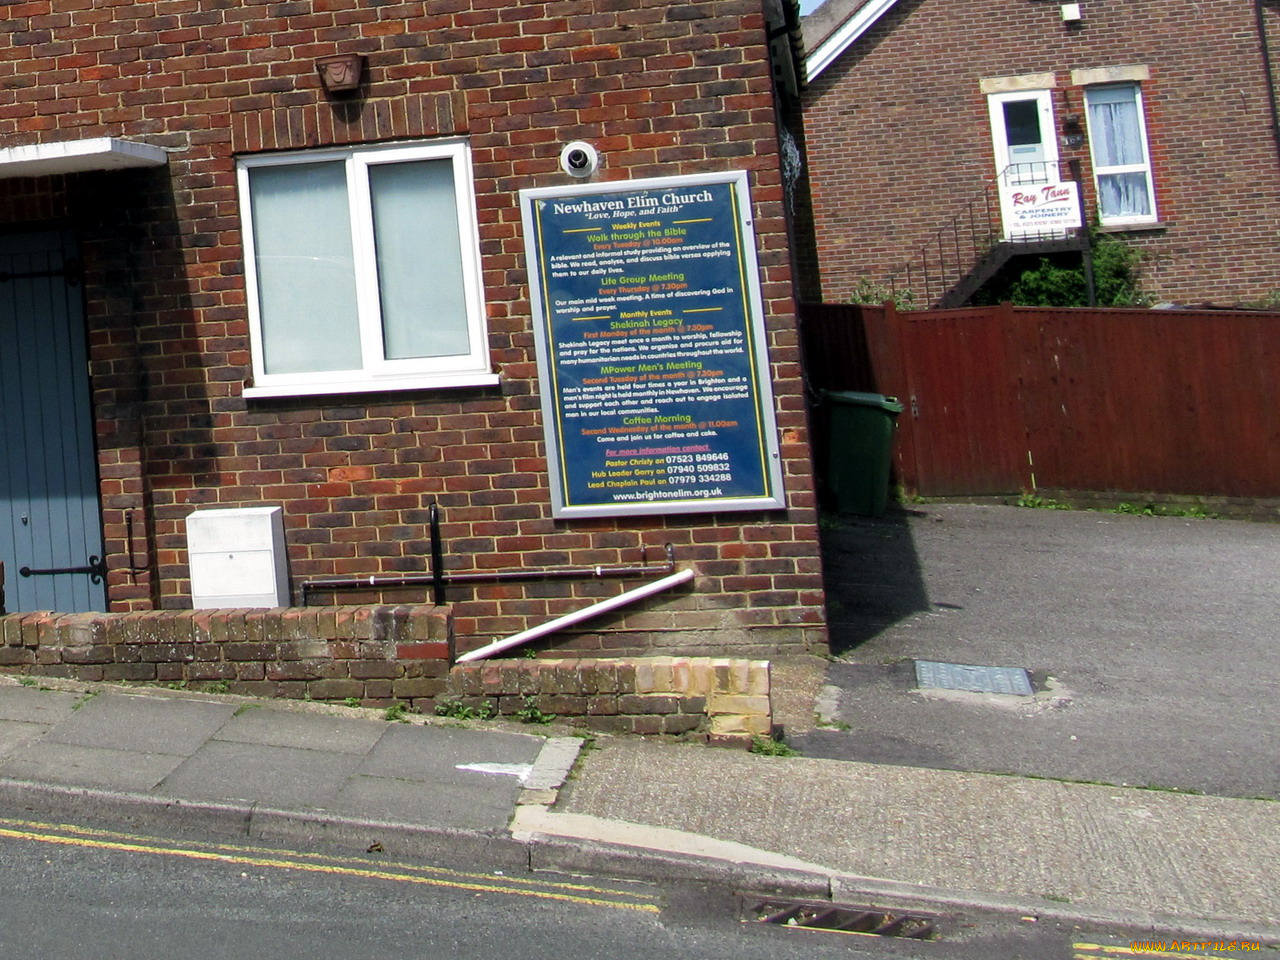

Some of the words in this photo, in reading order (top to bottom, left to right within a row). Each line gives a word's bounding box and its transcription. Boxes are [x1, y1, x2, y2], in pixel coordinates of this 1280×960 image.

[1012, 192, 1037, 207] Ray
[1041, 185, 1071, 201] Tann
[554, 201, 623, 214] Newhaven
[627, 195, 658, 208] Elim
[662, 190, 712, 205] Church
[1015, 207, 1072, 215] CARPENTRY
[612, 222, 637, 230] Weekly
[587, 233, 608, 242] Walk
[610, 231, 645, 242] through
[647, 229, 662, 237] the
[664, 227, 686, 236] Bible
[641, 246, 672, 255] providing
[601, 277, 616, 285] Life
[619, 276, 646, 284] Group
[648, 272, 684, 281] Meeting
[610, 319, 650, 329] Shekinah
[652, 318, 683, 327] Legacy
[600, 366, 635, 374] MPower
[666, 361, 702, 370] Meeting
[623, 416, 651, 424] Coffee
[654, 414, 691, 425] Morning
[665, 454, 693, 463] 07523
[695, 452, 728, 462] 849646
[667, 465, 694, 473] 07940
[697, 463, 729, 472] 509832
[606, 480, 638, 488] Chaplain
[668, 475, 696, 484] 07979
[698, 473, 731, 482] 334288
[613, 488, 721, 500] www.brightonelim.org.uk
